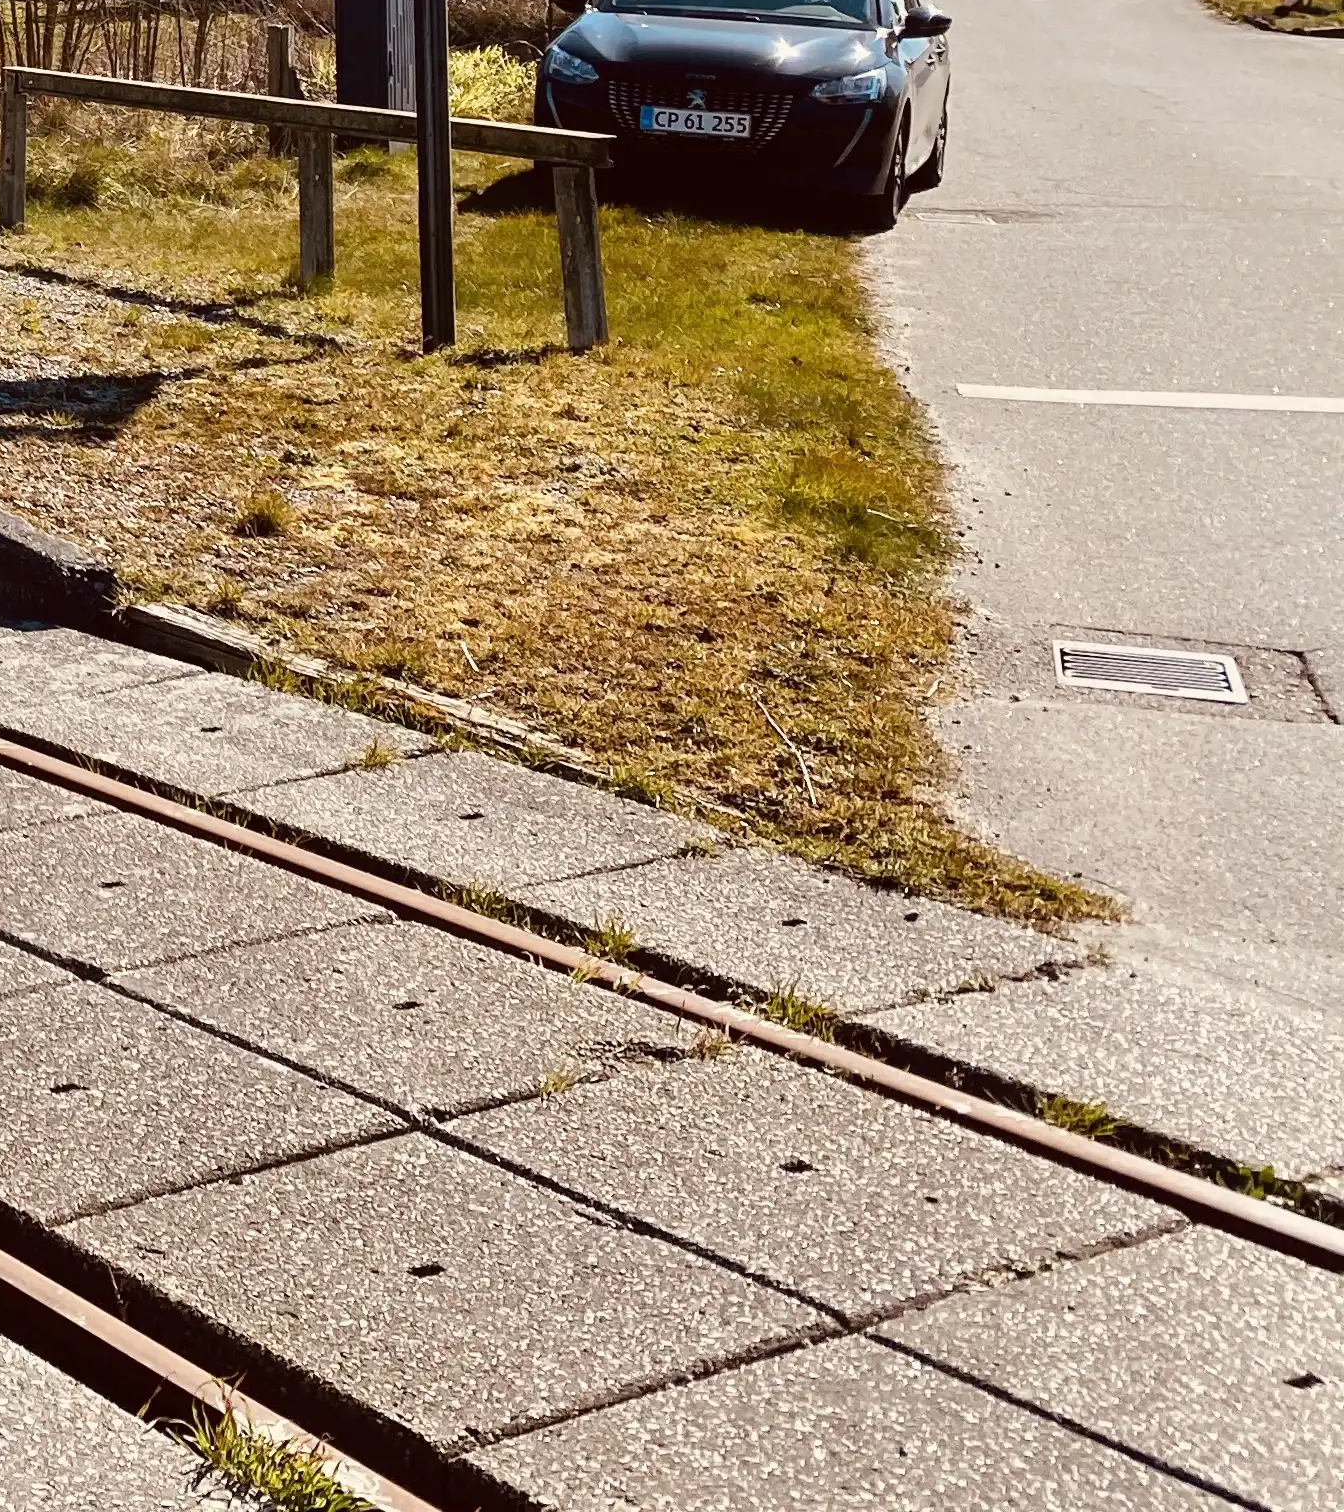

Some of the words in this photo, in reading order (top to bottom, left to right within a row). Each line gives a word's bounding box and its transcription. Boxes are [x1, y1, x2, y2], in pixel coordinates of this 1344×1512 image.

[654, 111, 679, 128] CP
[684, 113, 705, 130] 61
[712, 116, 747, 133] 255
